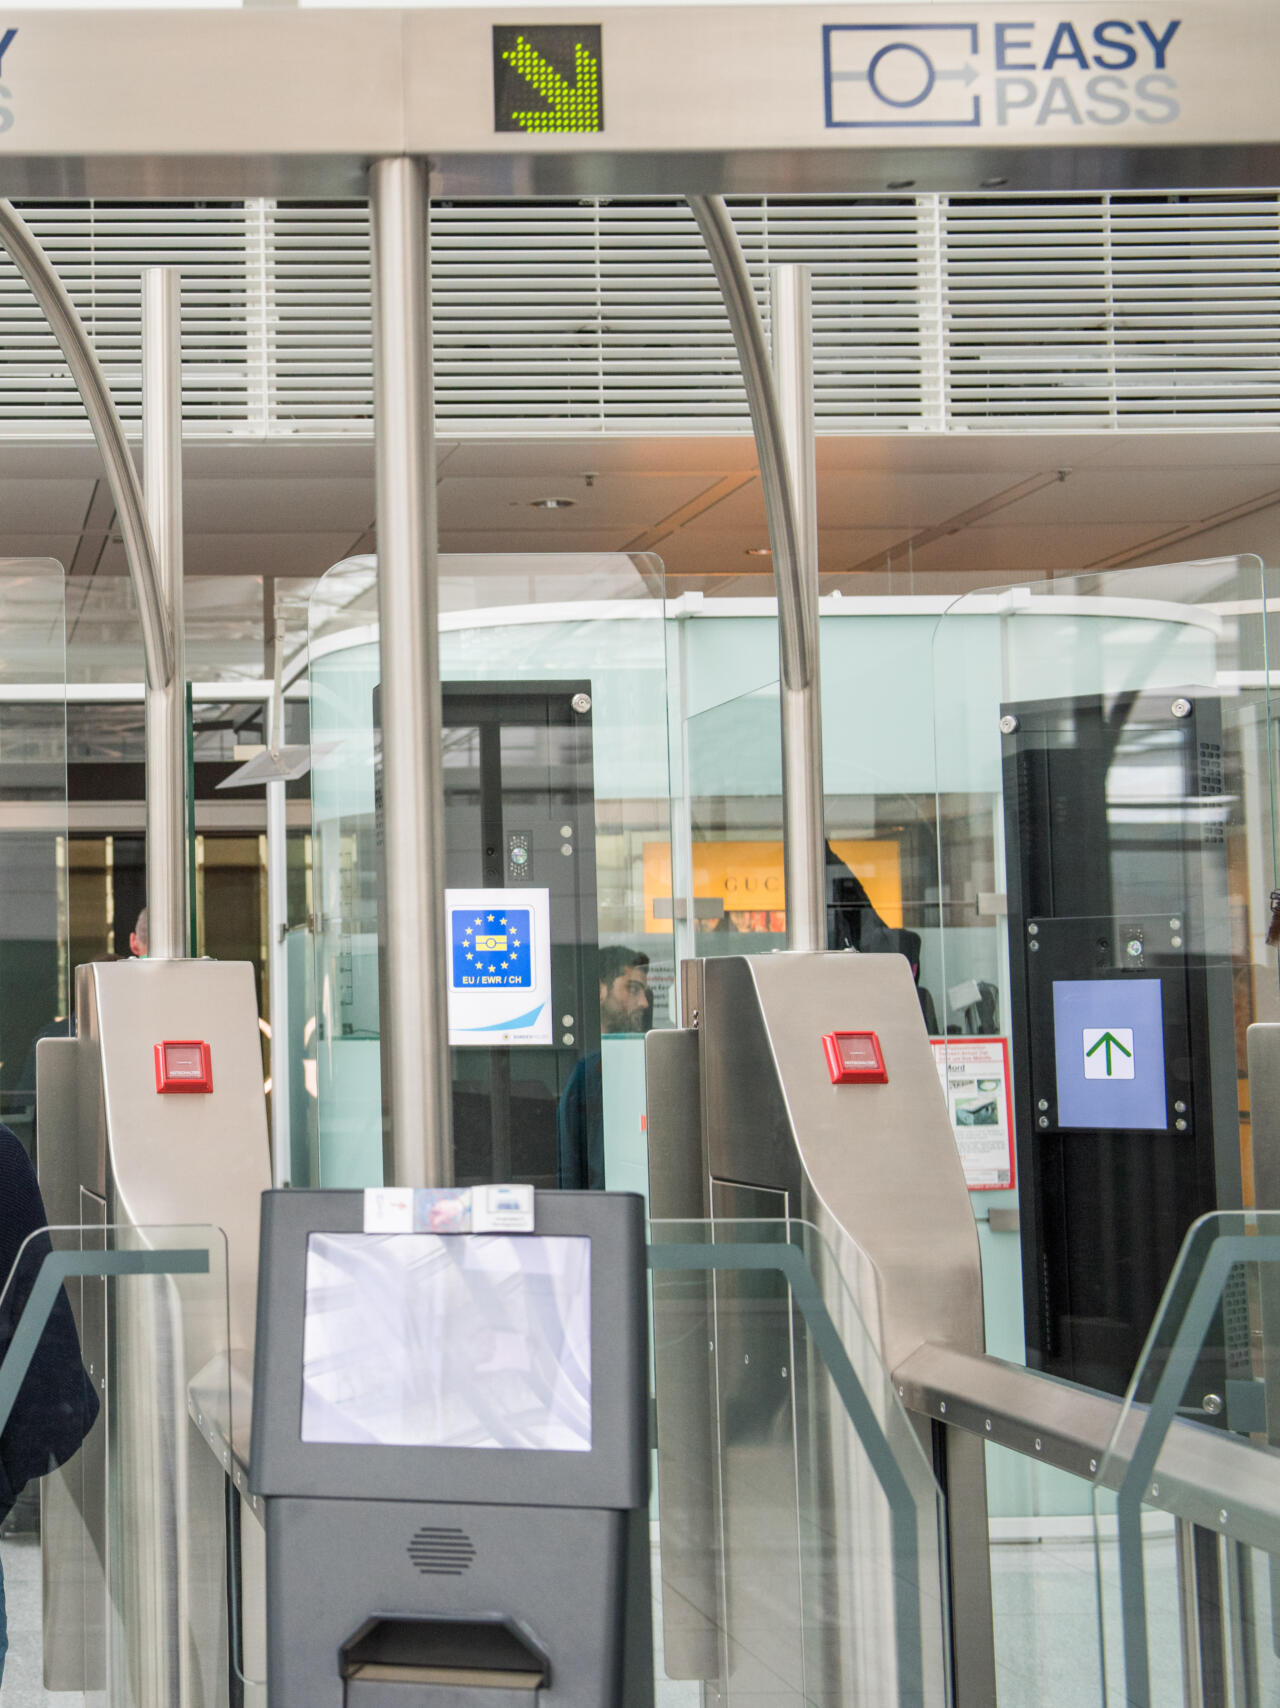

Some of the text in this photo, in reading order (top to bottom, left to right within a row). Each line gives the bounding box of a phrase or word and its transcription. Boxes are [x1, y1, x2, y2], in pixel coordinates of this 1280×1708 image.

[993, 20, 1182, 72] EASY
[994, 74, 1182, 127] PASS
[724, 876, 780, 891] GUC
[462, 975, 475, 985] EU
[481, 975, 503, 985] EWR
[508, 975, 522, 985] CH
